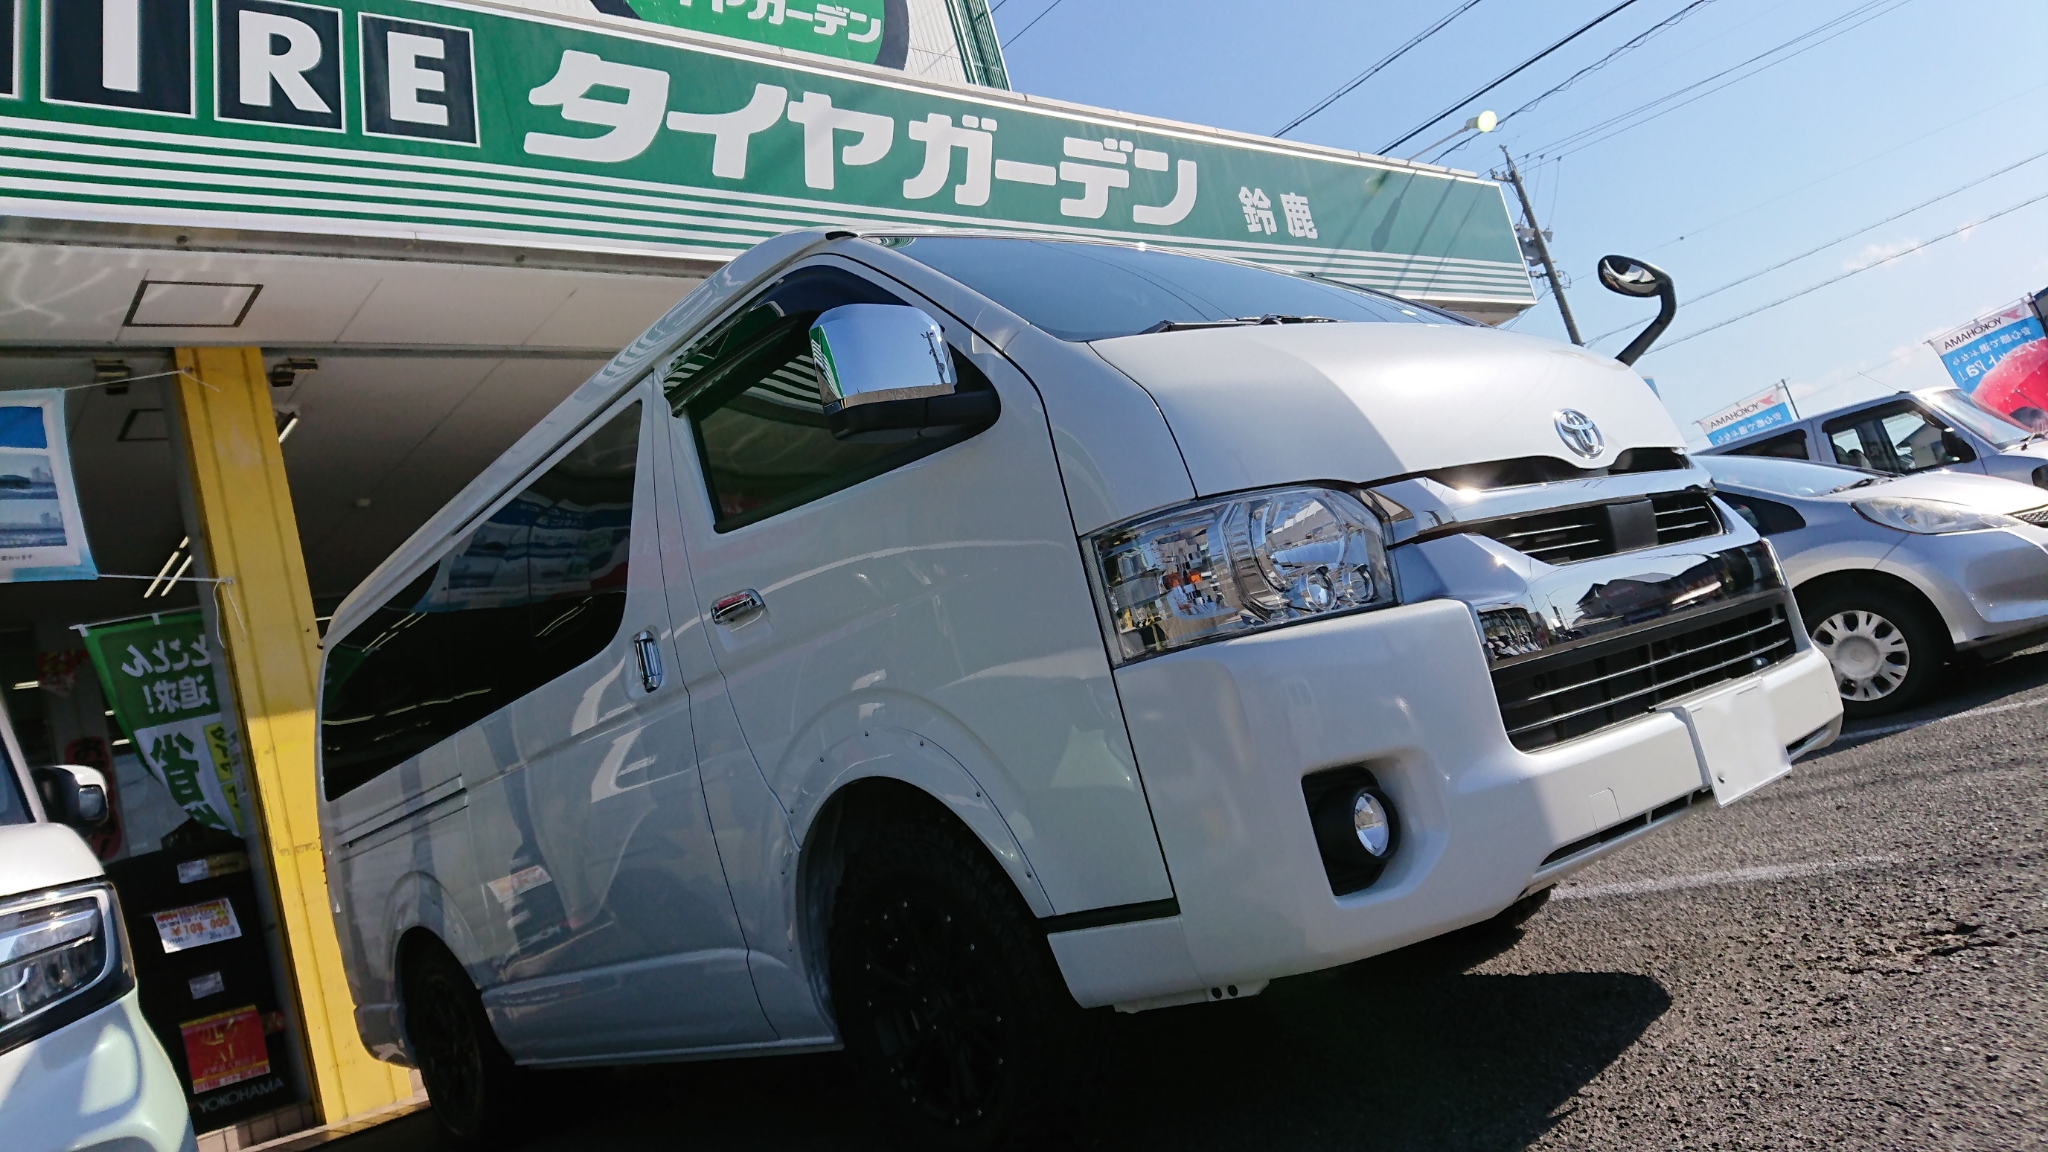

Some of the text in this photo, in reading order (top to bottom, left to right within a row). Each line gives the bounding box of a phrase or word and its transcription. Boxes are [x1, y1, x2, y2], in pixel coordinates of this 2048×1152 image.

[523, 50, 1197, 225] タイヤガーデン
[1238, 186, 1318, 239] 鈴鹿
[199, 1077, 284, 1113] YOKOHAMA
